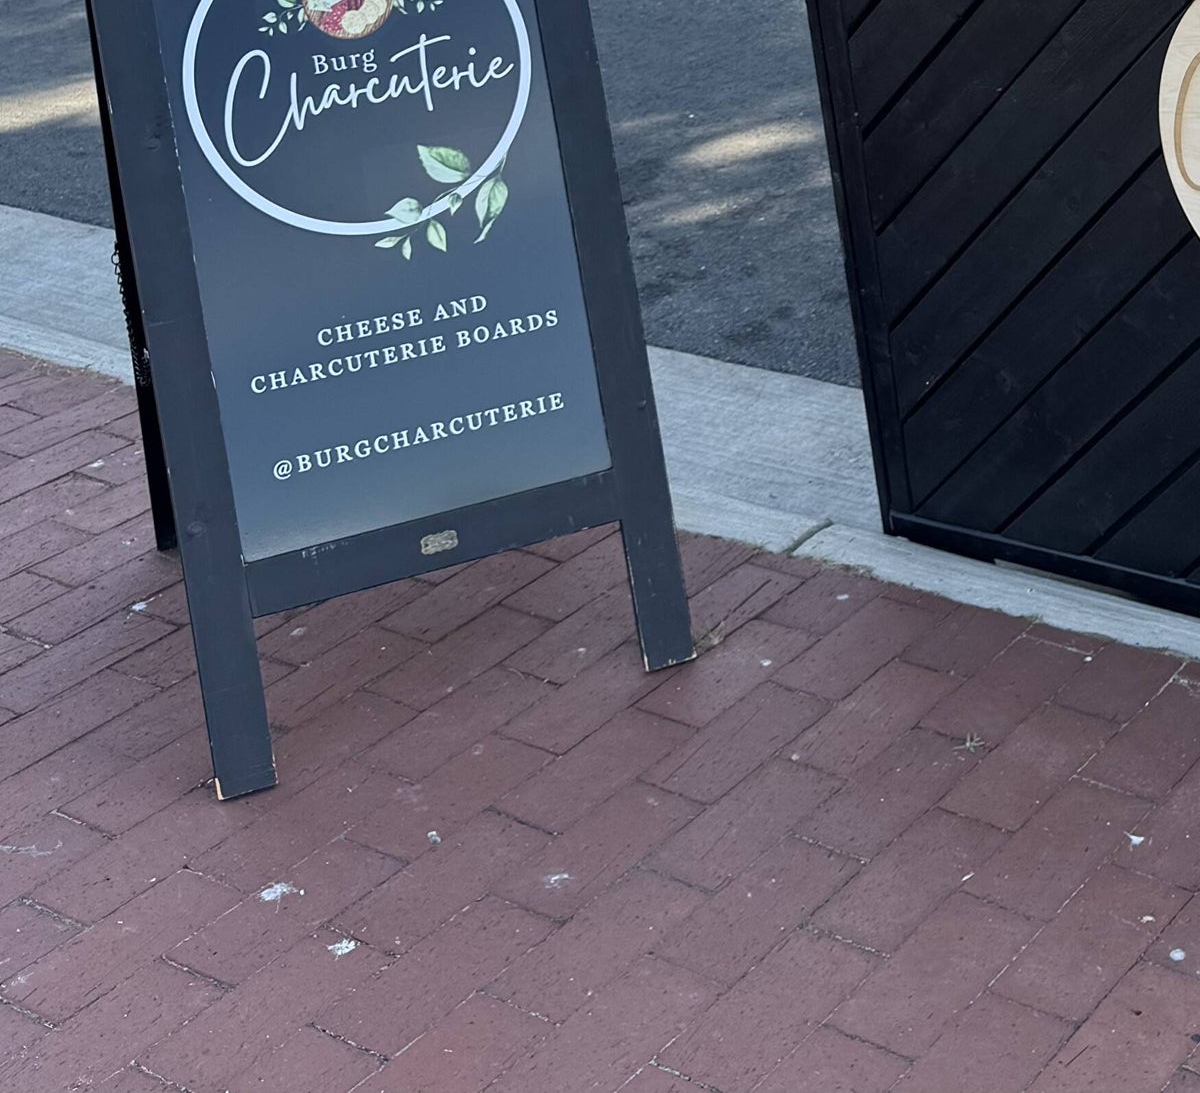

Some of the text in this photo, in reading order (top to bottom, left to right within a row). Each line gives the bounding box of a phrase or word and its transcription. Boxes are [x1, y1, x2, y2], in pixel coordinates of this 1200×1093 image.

[224, 33, 515, 167] Charcuterie
[311, 48, 378, 75] Burg
[250, 309, 560, 394] CHARCUTERIE BOARDS
[316, 294, 489, 347] CHEESE AND
[272, 392, 566, 481] @BURGCHARCUTERIE
